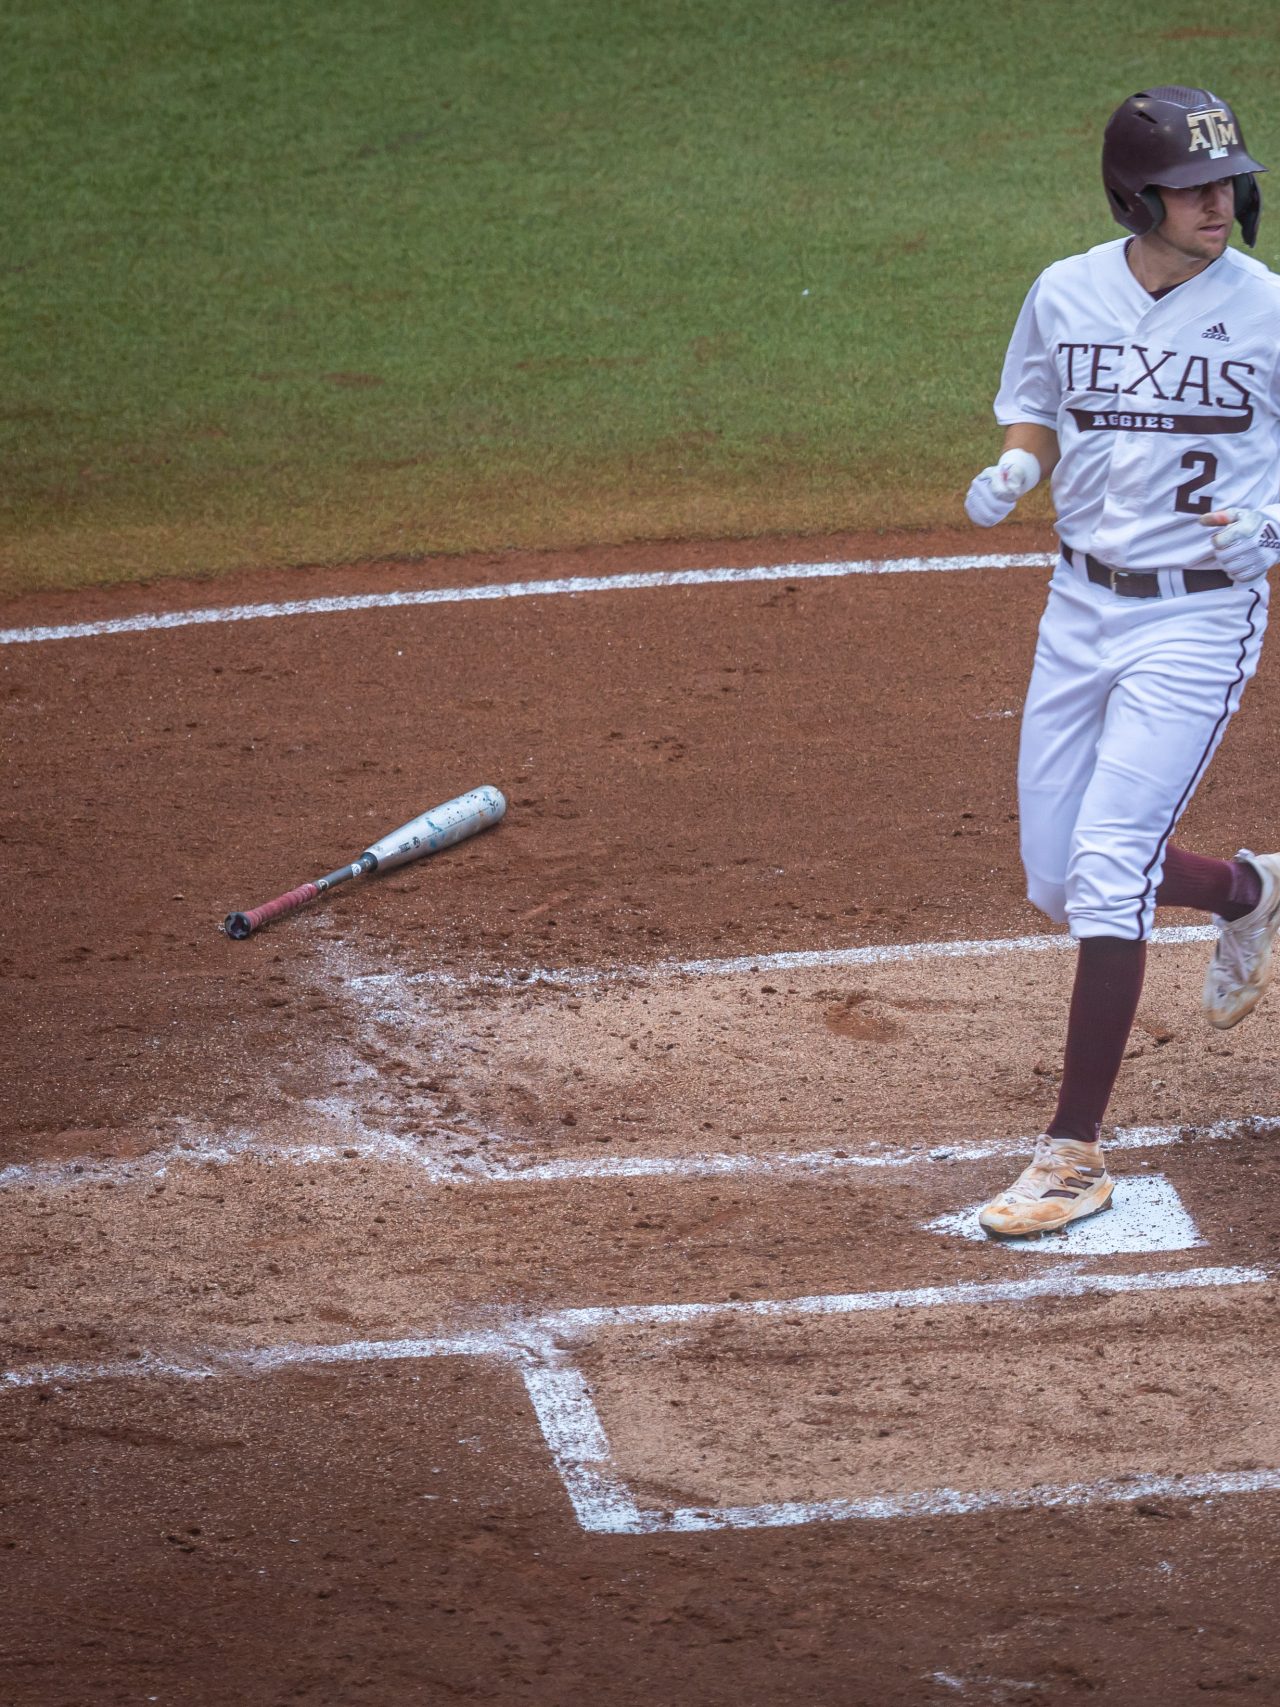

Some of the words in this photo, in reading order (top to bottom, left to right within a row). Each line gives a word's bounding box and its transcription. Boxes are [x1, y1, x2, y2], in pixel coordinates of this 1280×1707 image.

[1201, 332, 1230, 342] adidas
[1058, 343, 1255, 409] TEXAS
[1092, 413, 1175, 431] AGGIES
[1175, 450, 1218, 514] 2
